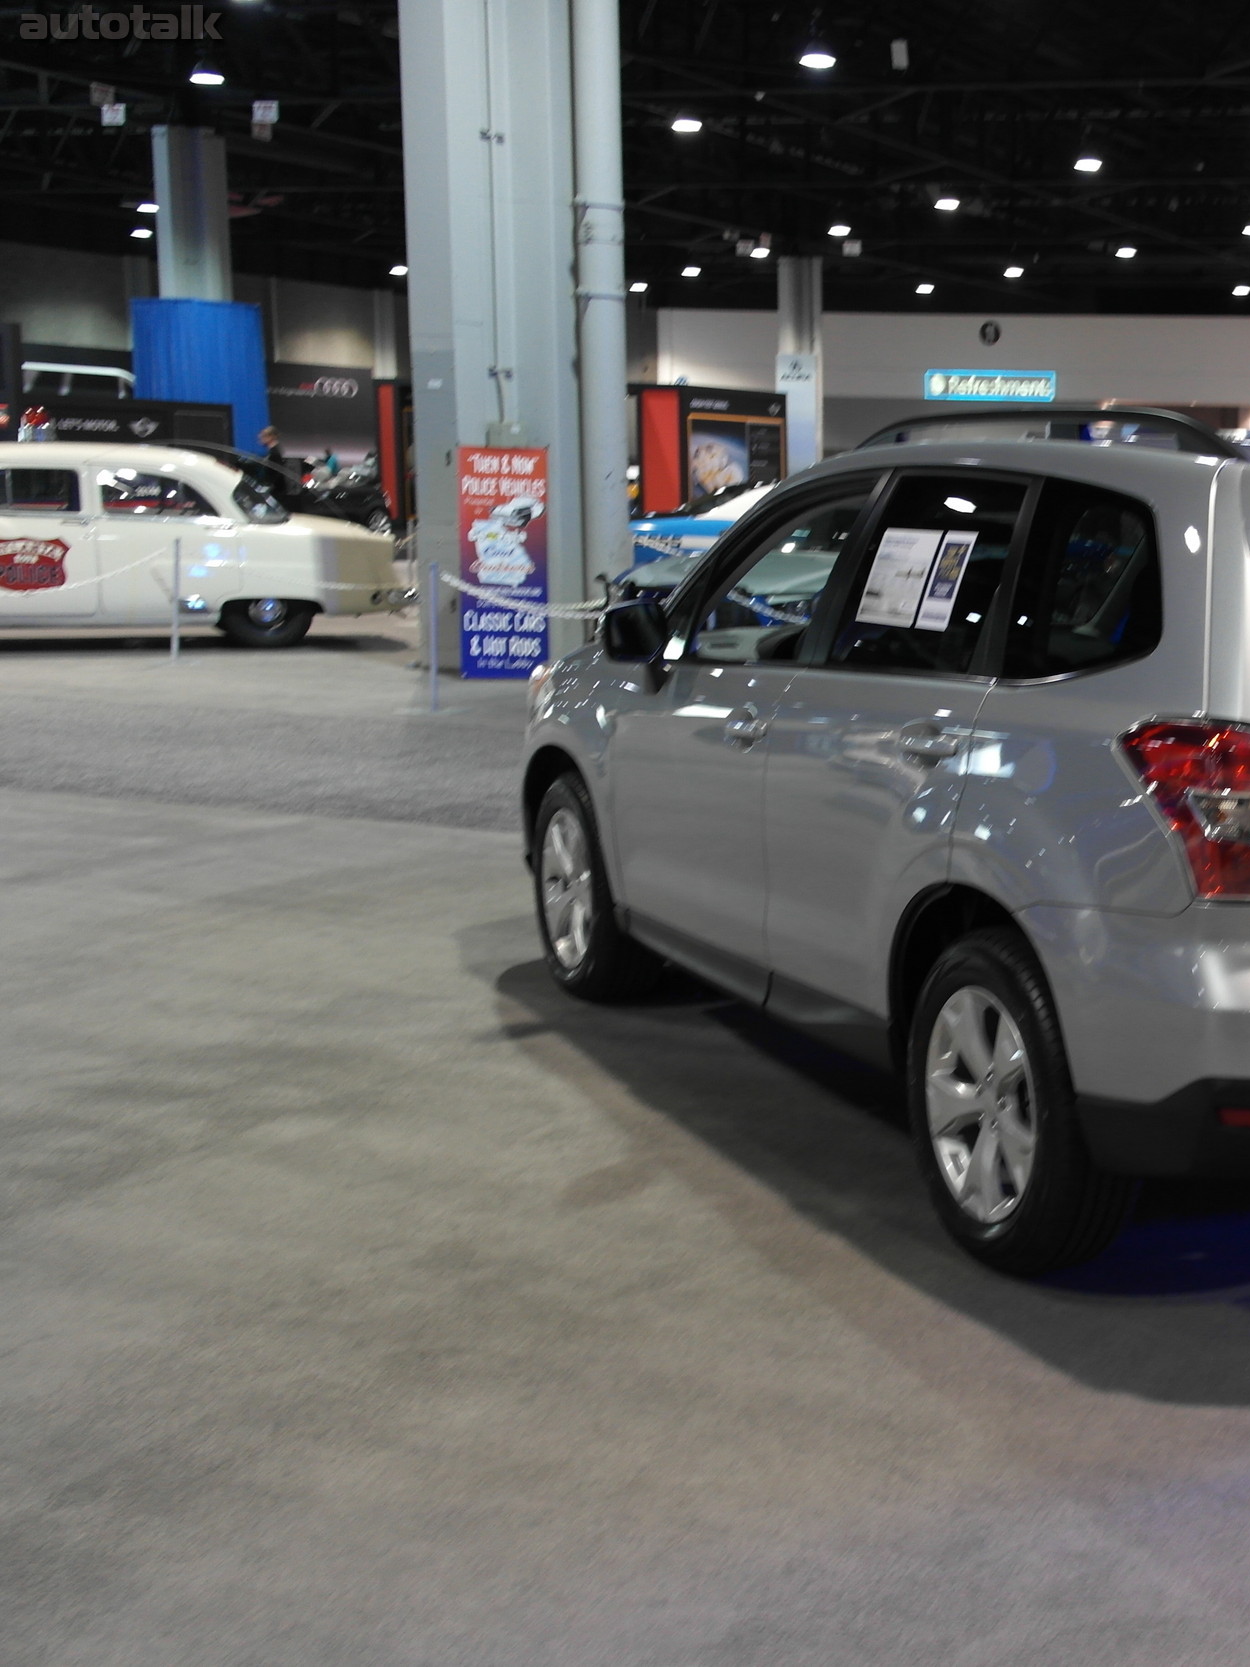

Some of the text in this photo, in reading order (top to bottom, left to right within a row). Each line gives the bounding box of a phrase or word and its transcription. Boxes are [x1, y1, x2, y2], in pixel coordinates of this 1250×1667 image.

[461, 475, 546, 497] POLICE VEHICLES
[463, 609, 546, 633] CLASSIC CARS
[469, 634, 542, 658] & HOT RODS
